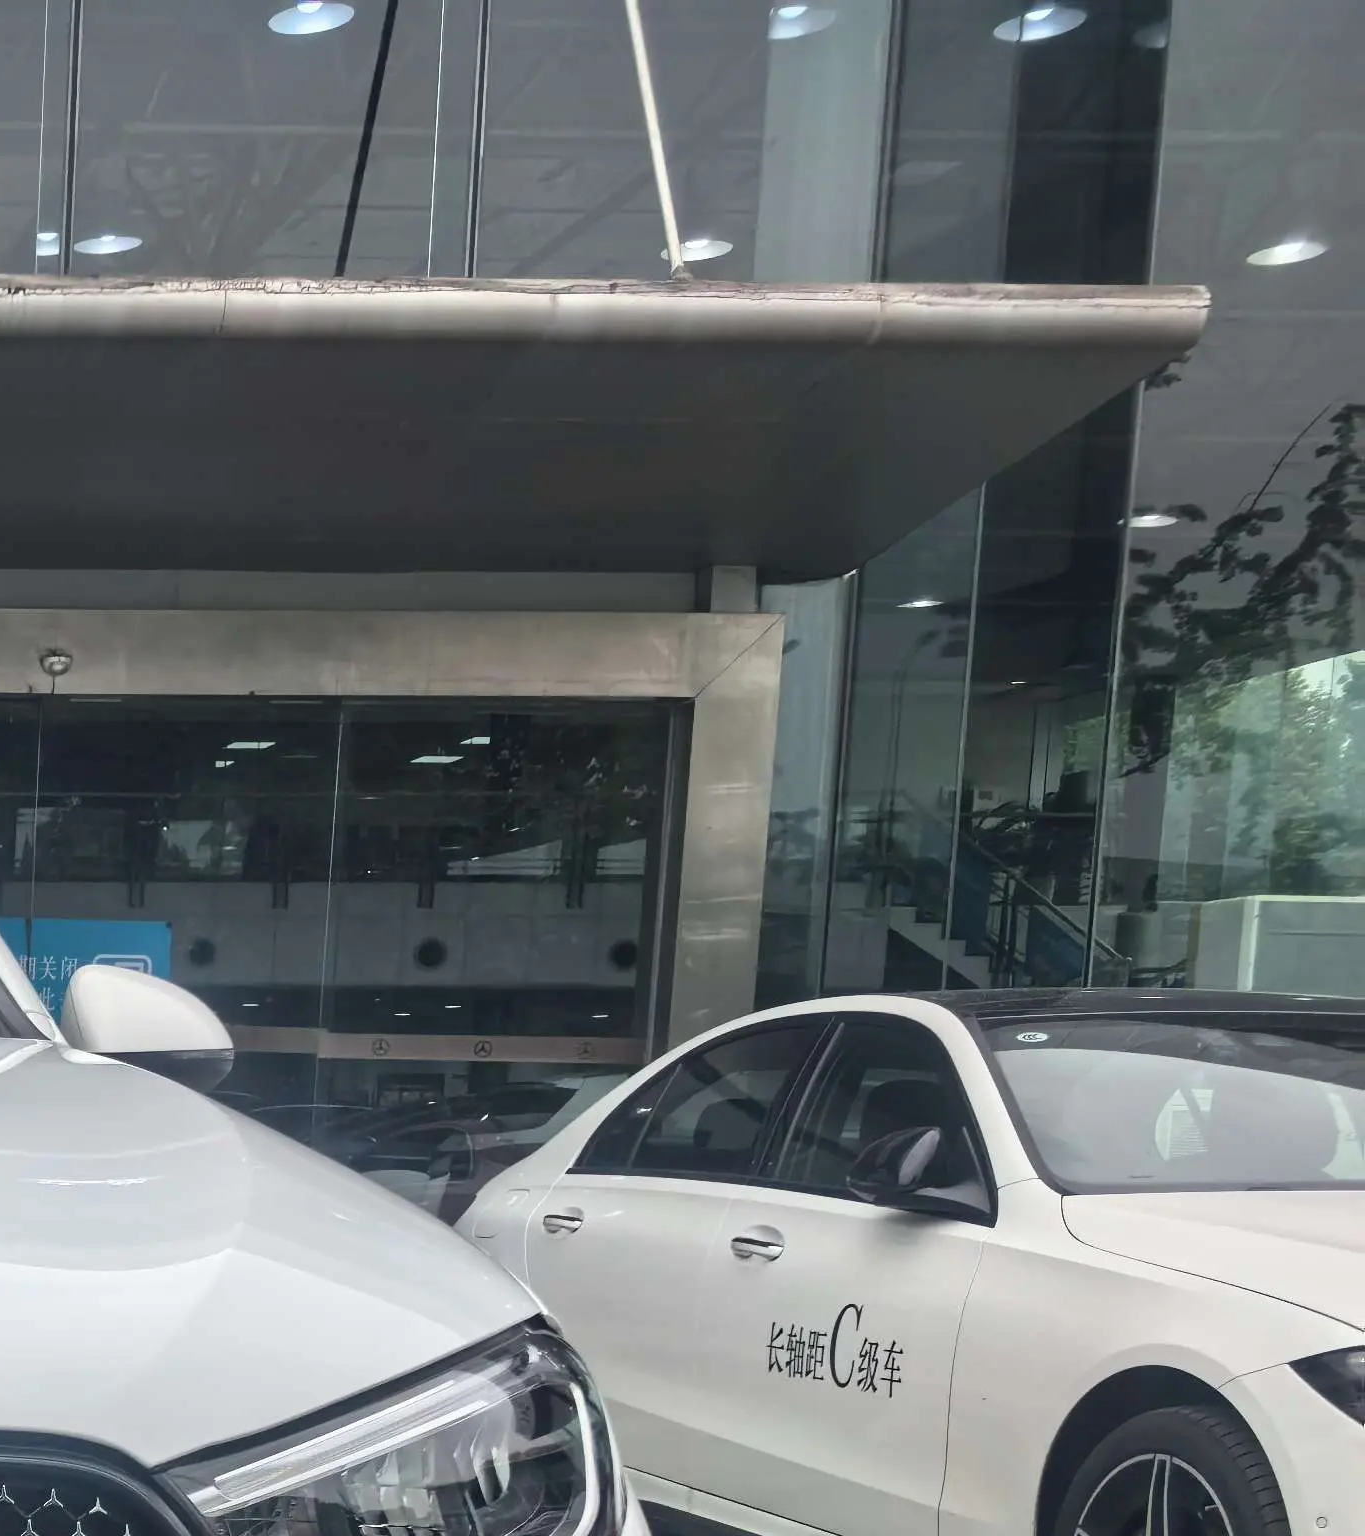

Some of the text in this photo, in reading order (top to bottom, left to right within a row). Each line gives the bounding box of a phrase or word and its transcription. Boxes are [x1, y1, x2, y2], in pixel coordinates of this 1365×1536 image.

[766, 1303, 904, 1398] 长轴距C级车
